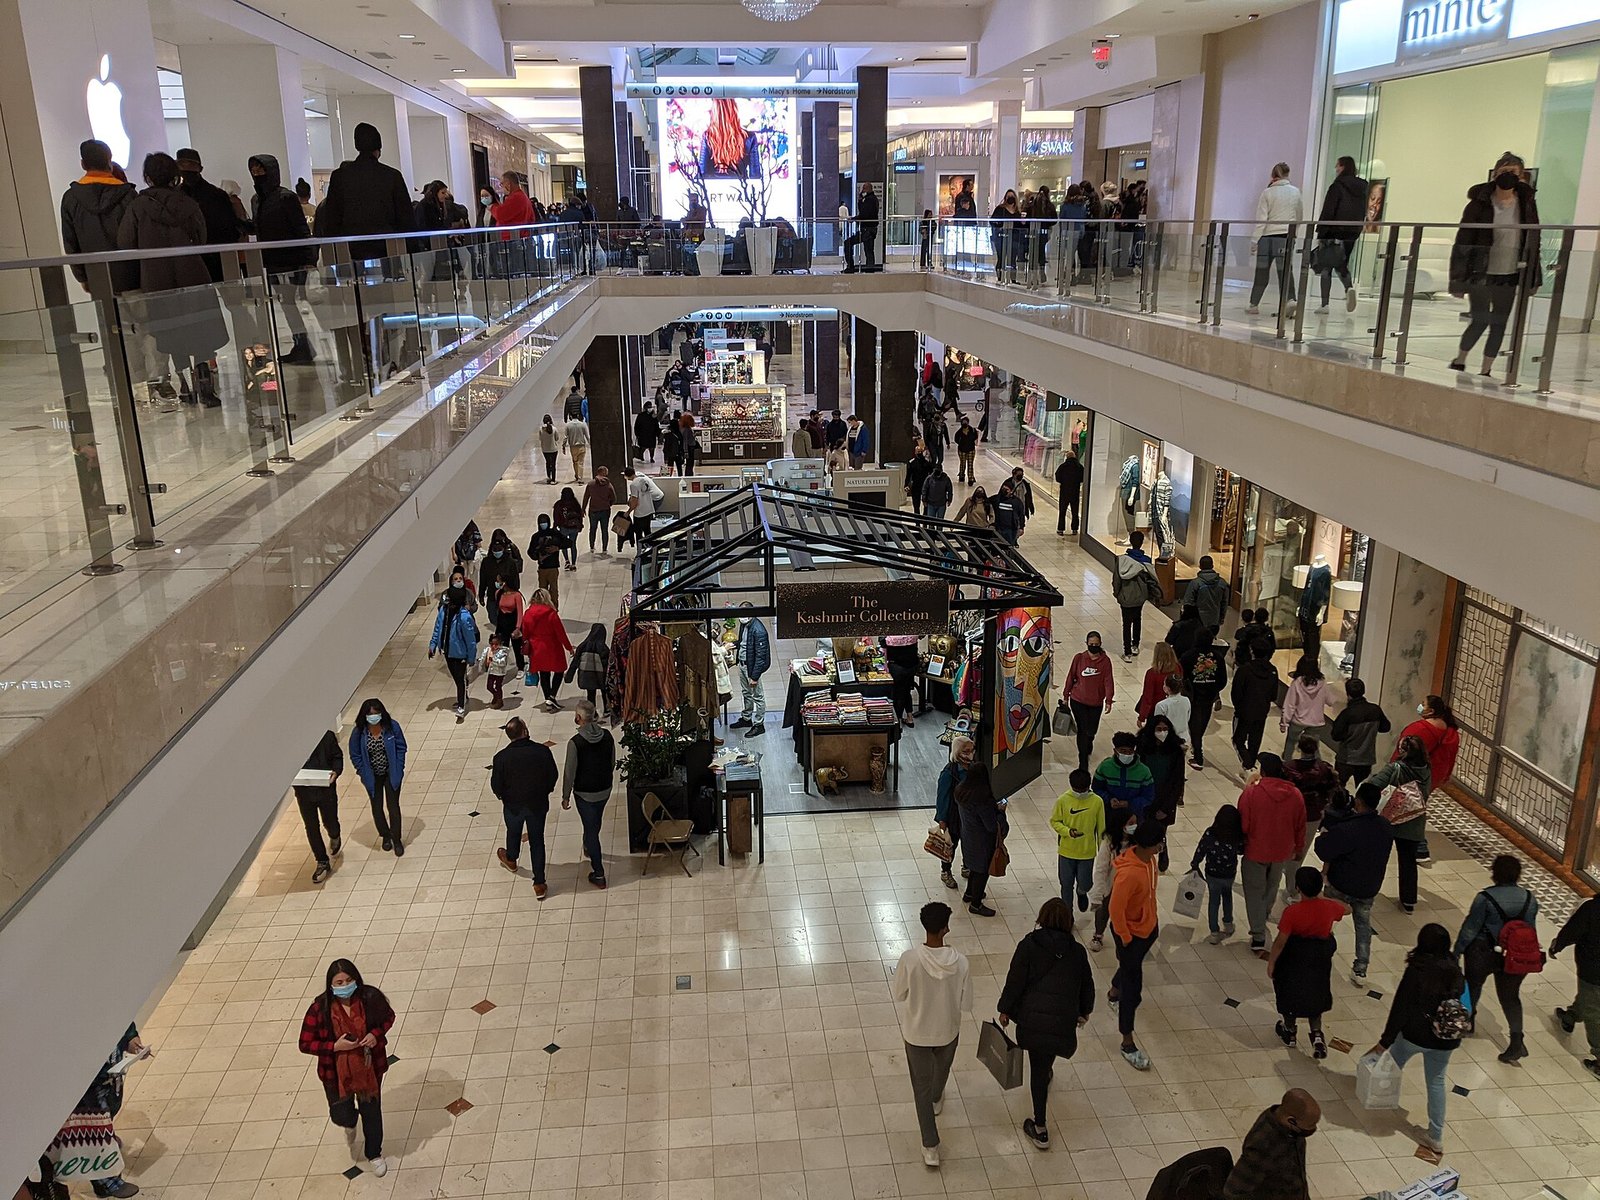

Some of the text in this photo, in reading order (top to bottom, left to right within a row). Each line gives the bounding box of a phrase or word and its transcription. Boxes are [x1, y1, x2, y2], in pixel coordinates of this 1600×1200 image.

[708, 193, 723, 203] RT
[851, 596, 878, 608] The
[797, 609, 929, 624] Kashmir Collection
